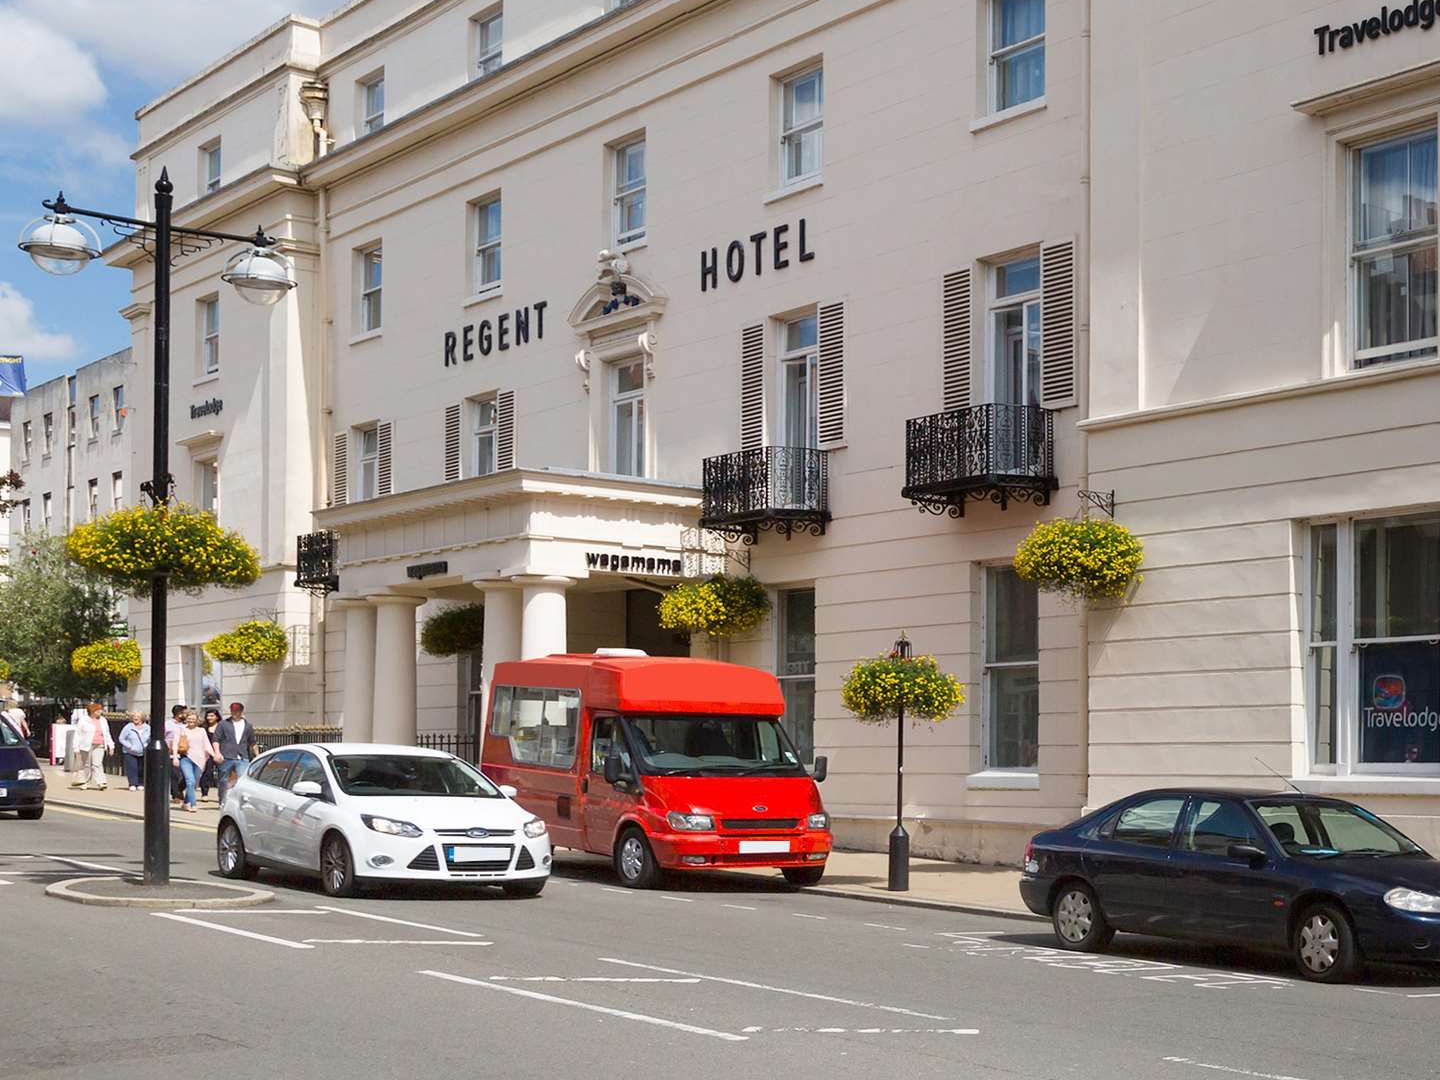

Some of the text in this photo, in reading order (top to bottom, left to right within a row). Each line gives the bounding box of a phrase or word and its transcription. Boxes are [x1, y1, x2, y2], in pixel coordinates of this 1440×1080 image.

[444, 218, 815, 367] REGENT HOTEL
[585, 552, 681, 574] wagamama
